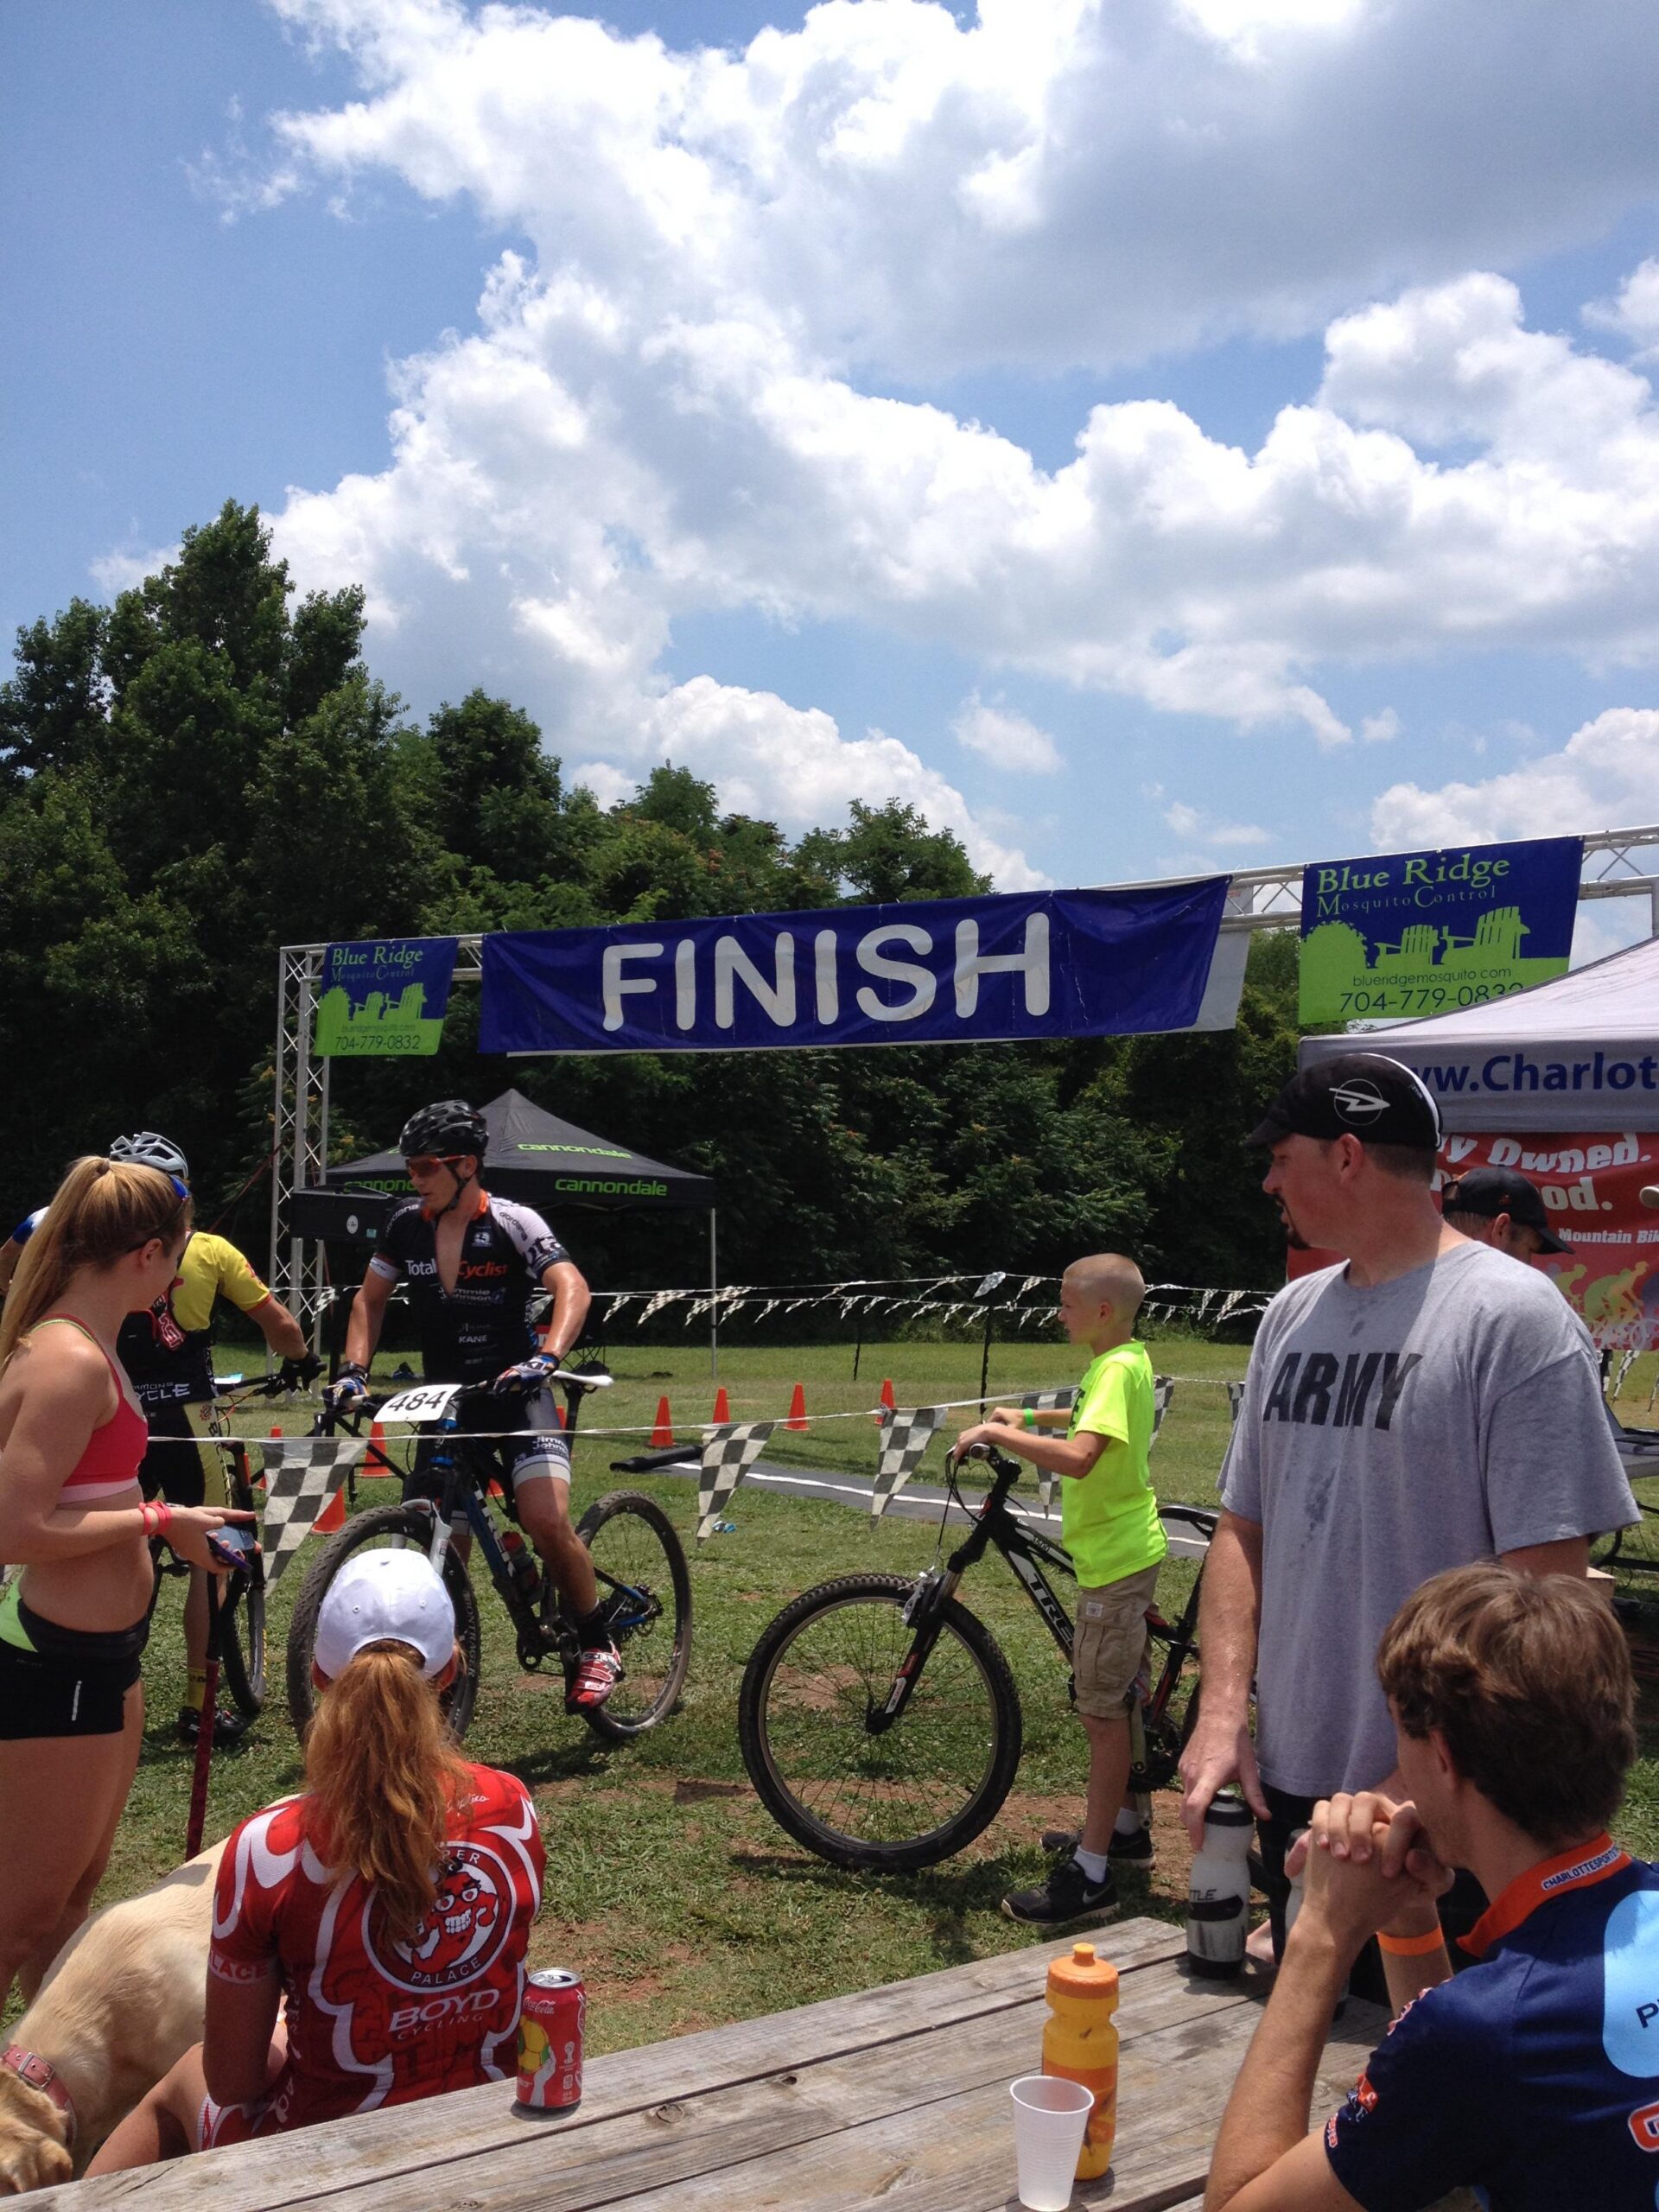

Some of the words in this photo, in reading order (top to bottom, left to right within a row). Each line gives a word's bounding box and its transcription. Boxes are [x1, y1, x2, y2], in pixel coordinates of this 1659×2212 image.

[1316, 868, 1390, 895] Blue
[1402, 852, 1511, 889] Ridge
[1316, 893, 1411, 918] Mosquito
[1414, 885, 1497, 908] Control
[331, 947, 368, 966] Blue
[372, 944, 423, 969] Ridge
[601, 912, 1051, 1032] FINISH
[1352, 968, 1511, 987] blueridgemosquito.com
[335, 1034, 422, 1051] 704-779-0832
[518, 1143, 632, 1159] cannondale
[1487, 1132, 1652, 1173] Owned.
[555, 1179, 667, 1196] cannondale
[1558, 1228, 1632, 1244] Mountain
[405, 1257, 437, 1276] Total
[458, 1260, 508, 1279] Cyclist
[437, 1287, 490, 1296] Jmmie
[137, 1383, 190, 1401] YCLE
[387, 1390, 448, 1412] 484
[1263, 1352, 1422, 1431] ARMY
[1029, 1573, 1074, 1649] TRE
[442, 1849, 480, 1865] PER
[1189, 1889, 1217, 1901] TLE
[410, 1956, 481, 1985] PALACE
[388, 1988, 499, 2033] BOYD
[397, 2014, 483, 2040] CYCLING
